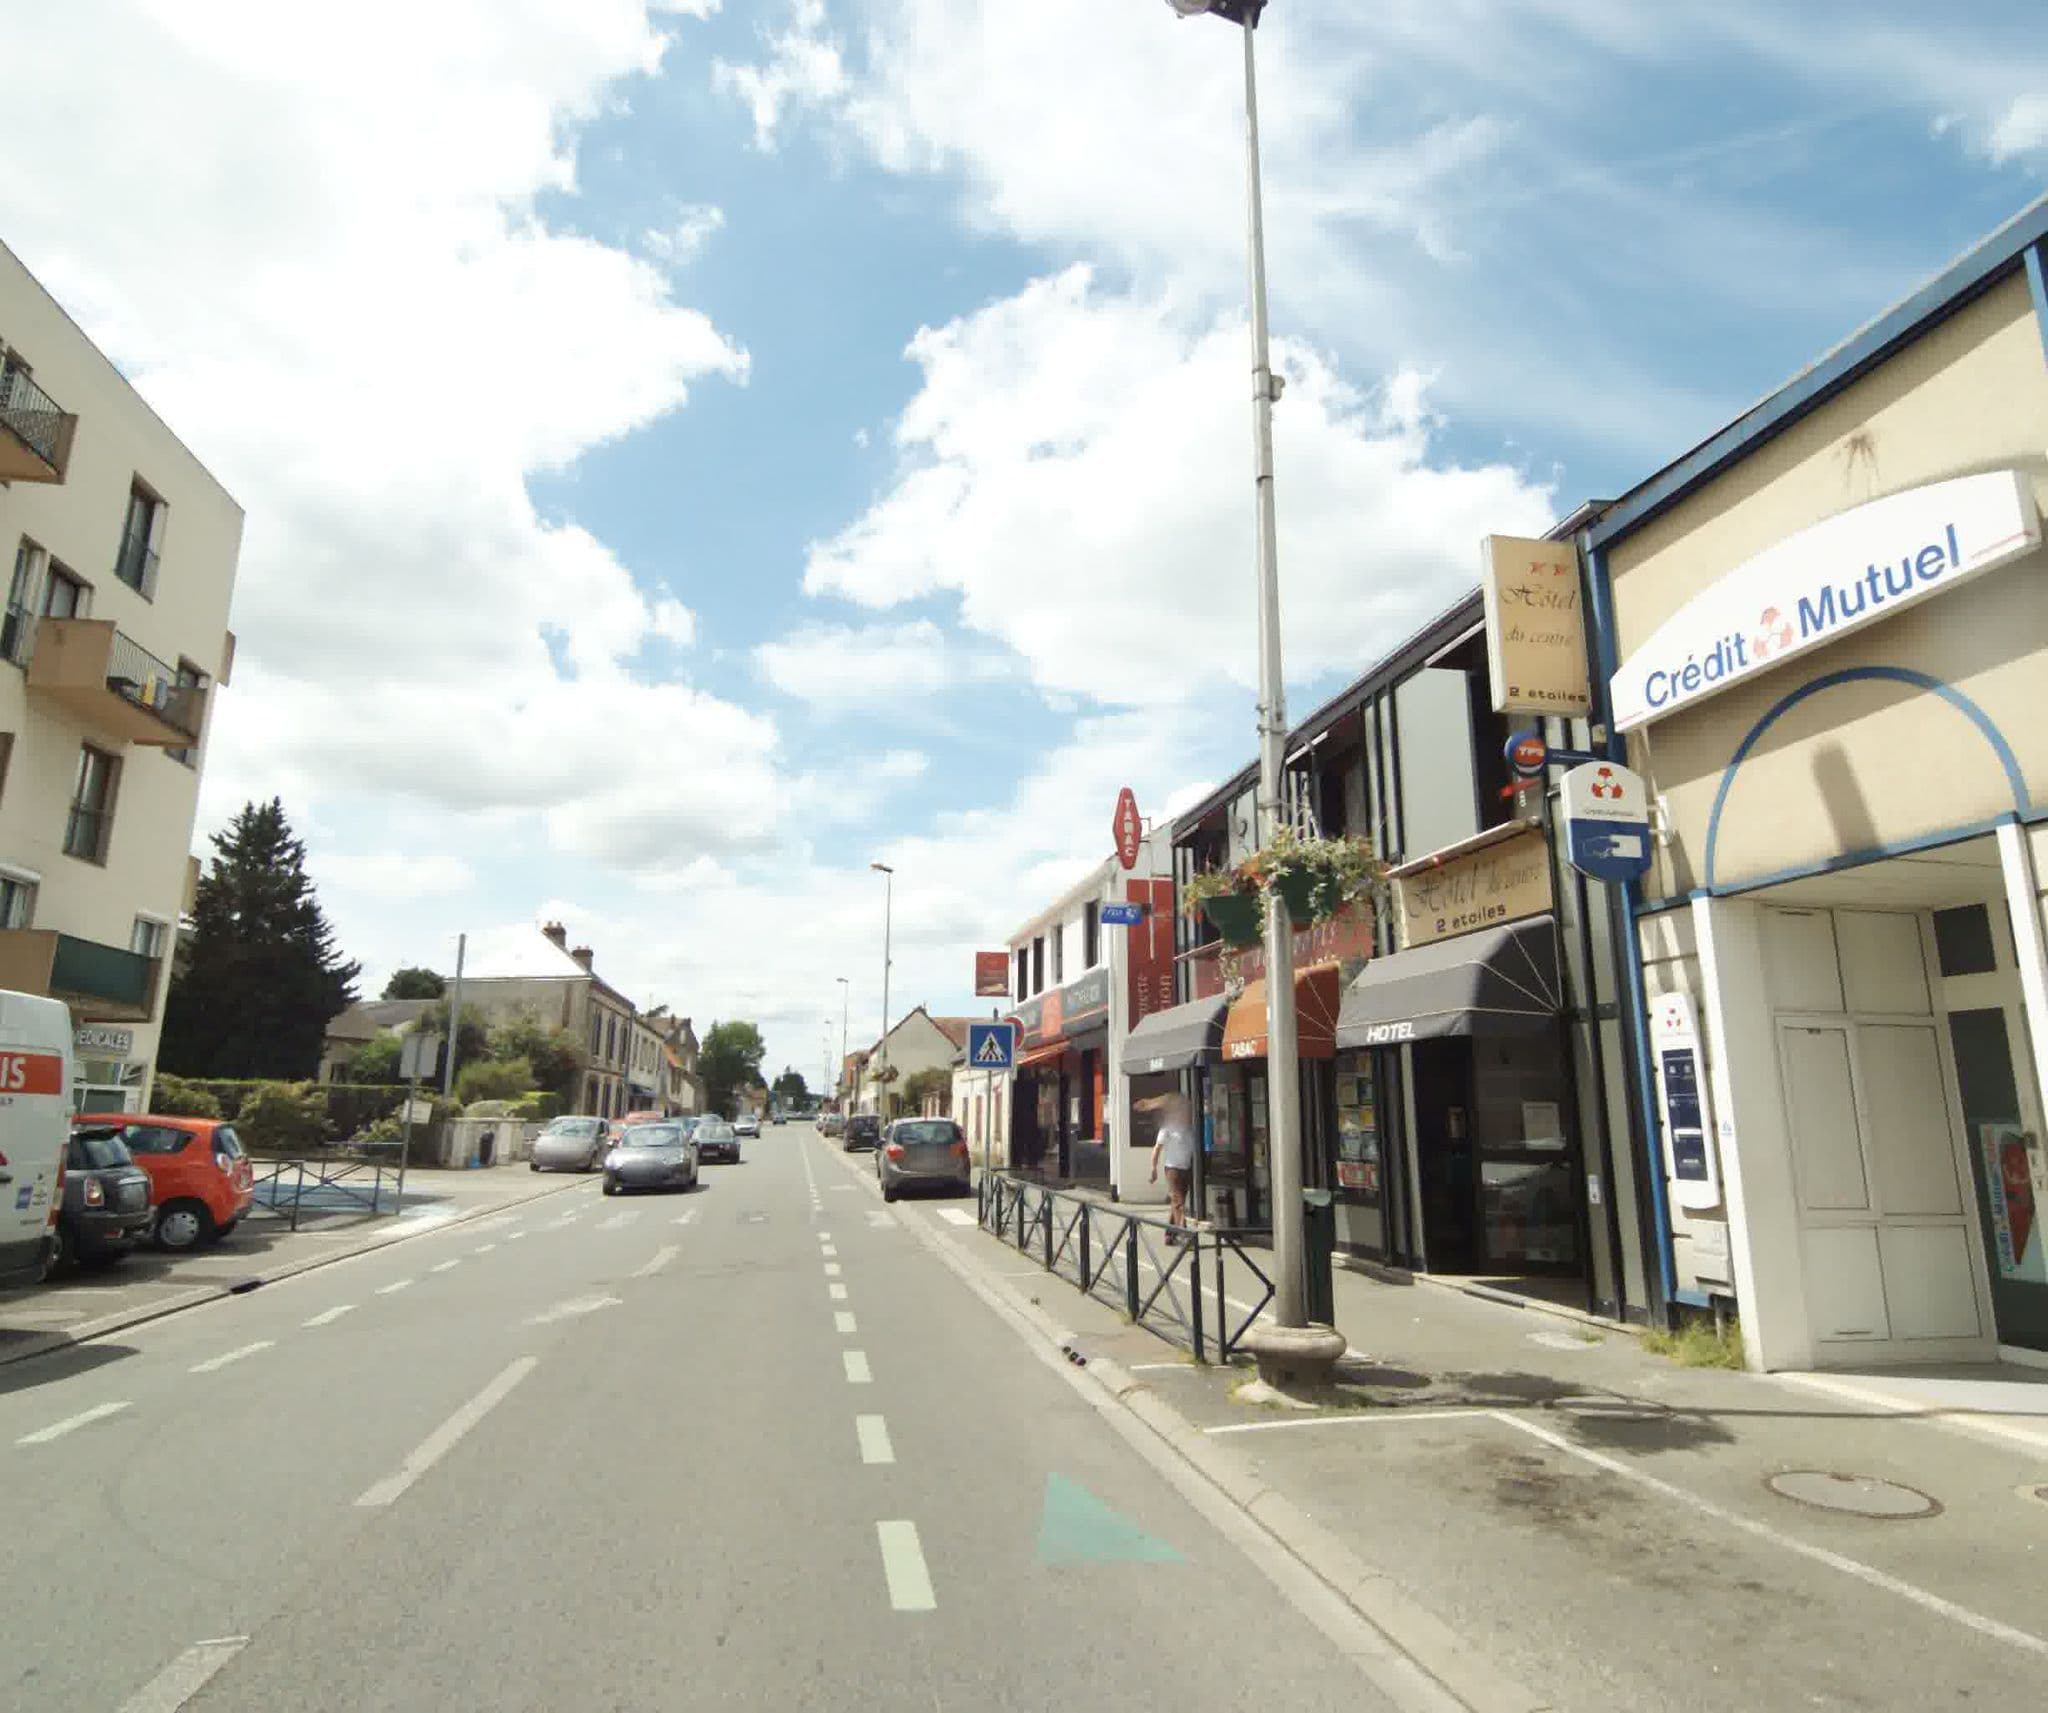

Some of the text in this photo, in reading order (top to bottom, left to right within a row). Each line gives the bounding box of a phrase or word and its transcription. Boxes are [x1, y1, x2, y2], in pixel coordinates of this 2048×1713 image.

[1645, 523, 1961, 708] Crédit Mutuel
[1124, 799, 1136, 857] TABAC
[1436, 918, 1447, 933] 2
[1367, 1022, 1416, 1042] HOTEL
